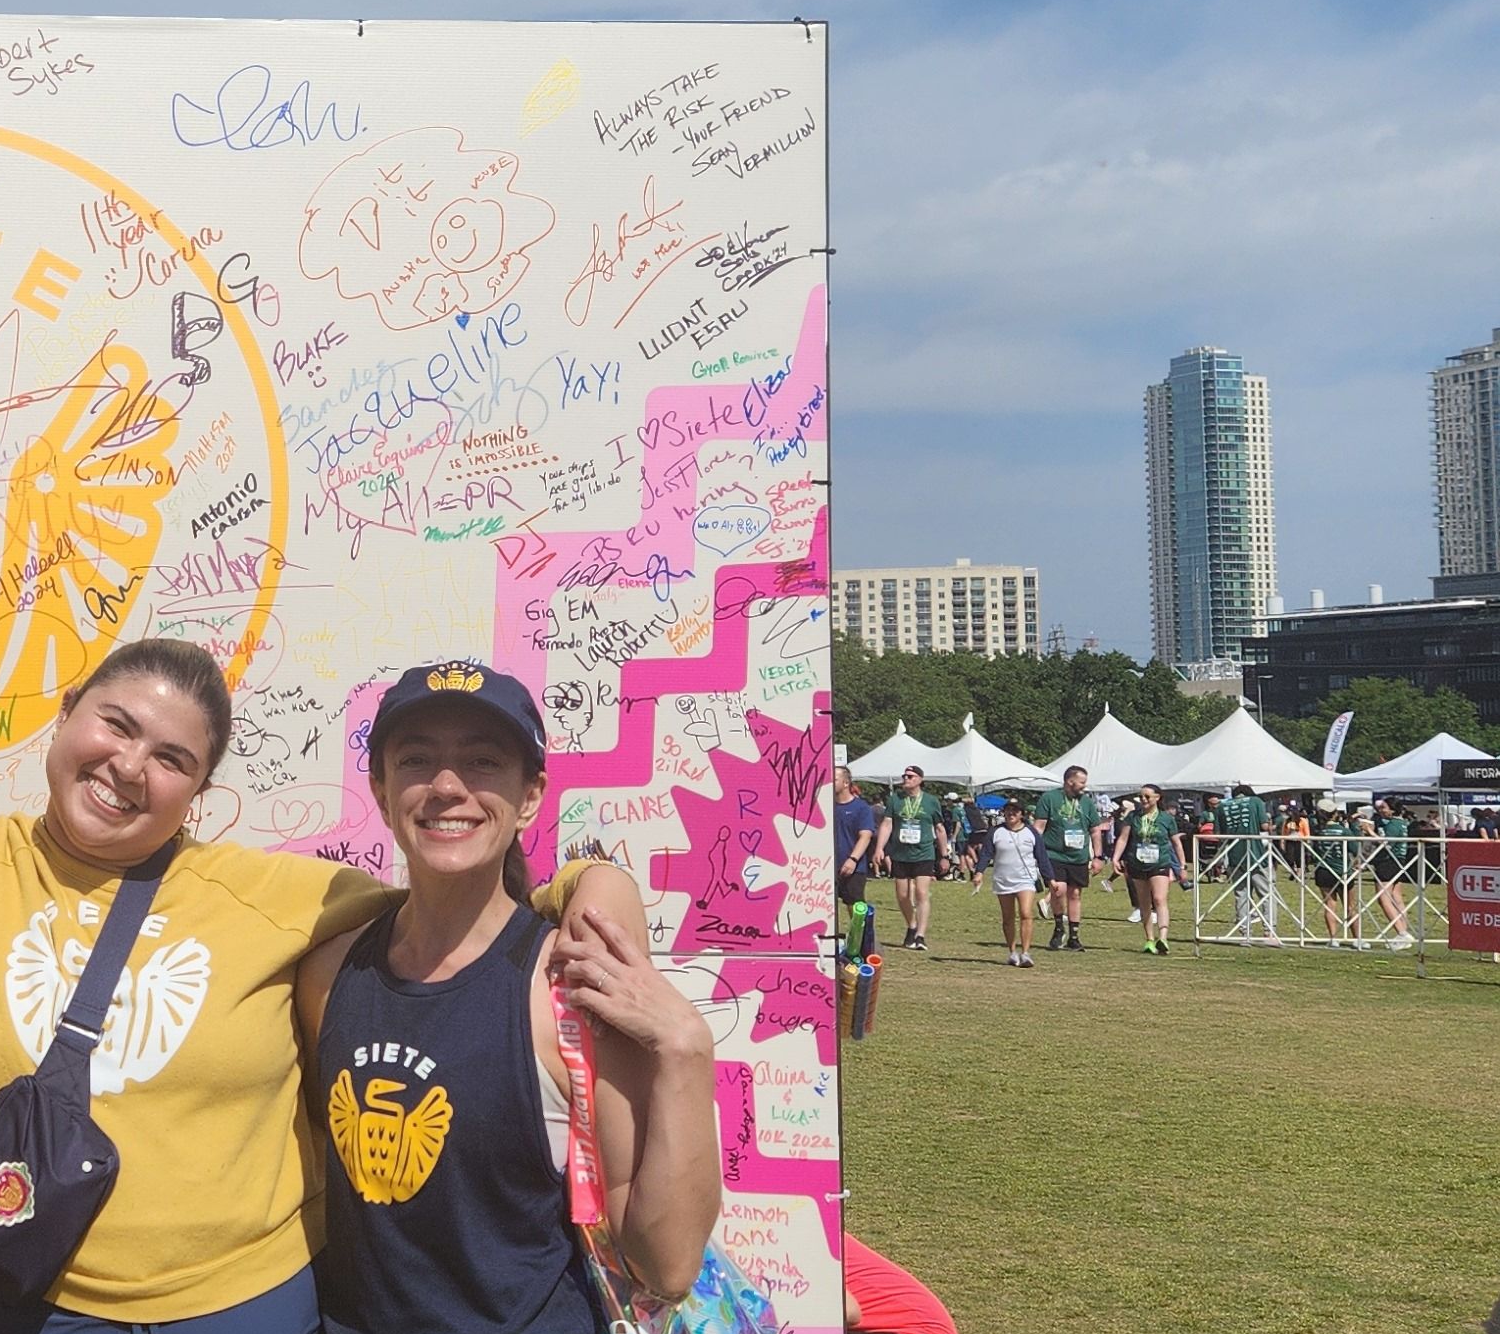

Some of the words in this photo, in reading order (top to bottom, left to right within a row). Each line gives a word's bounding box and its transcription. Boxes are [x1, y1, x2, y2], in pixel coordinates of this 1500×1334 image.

[7, 52, 95, 96] Sykes
[593, 89, 663, 146] ALWAYS
[660, 62, 721, 97] TAKE
[720, 87, 792, 127] FRIEND
[618, 126, 659, 157] THE
[663, 94, 716, 130] RISK
[691, 140, 740, 178] SEAN
[724, 107, 817, 179] VERMILLION
[272, 321, 349, 387] BLAKE
[555, 355, 622, 411] YaY!
[461, 426, 529, 452] NOTHING
[662, 395, 743, 448] Siete
[524, 599, 561, 639] Gig
[758, 657, 813, 682] VERDE!
[1330, 721, 1347, 755] MEDICAL
[598, 789, 677, 827] CLAIRE
[1461, 912, 1482, 927] WE
[353, 1041, 438, 1082] SIETE
